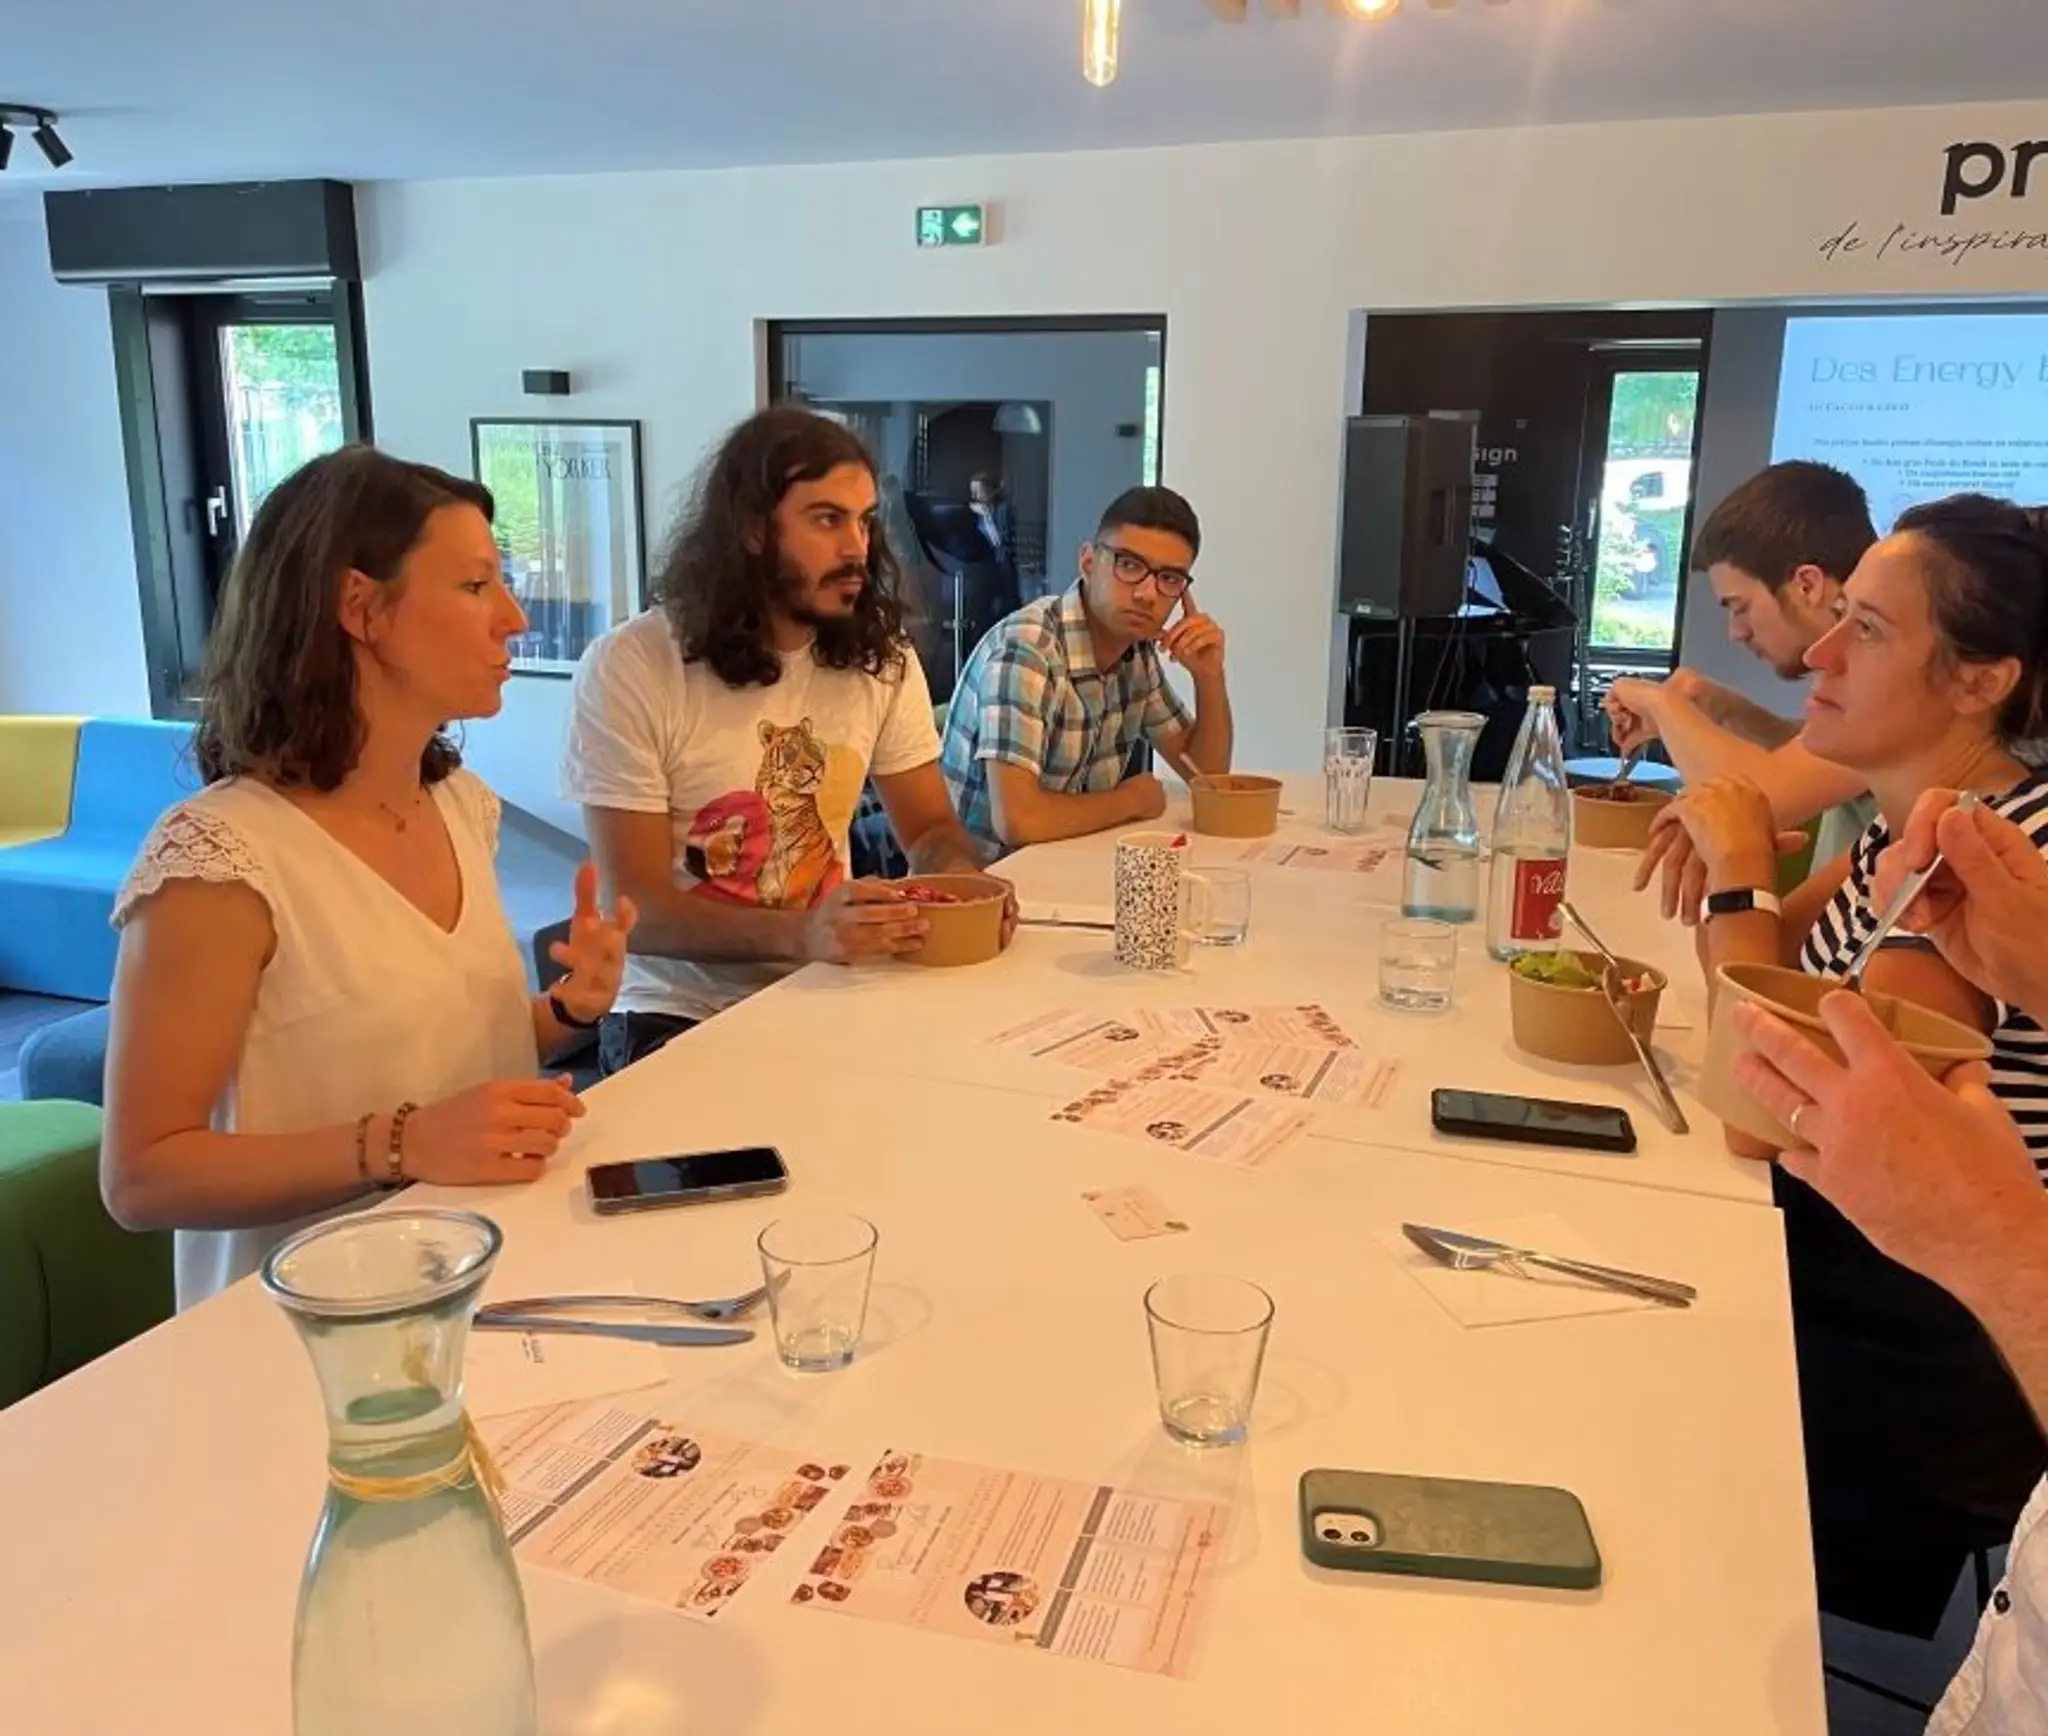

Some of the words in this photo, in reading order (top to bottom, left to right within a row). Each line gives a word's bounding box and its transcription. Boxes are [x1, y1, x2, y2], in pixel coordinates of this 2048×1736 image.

[1819, 220, 1866, 261] de
[1811, 355, 1877, 383] Des
[1893, 353, 2024, 390] Energy
